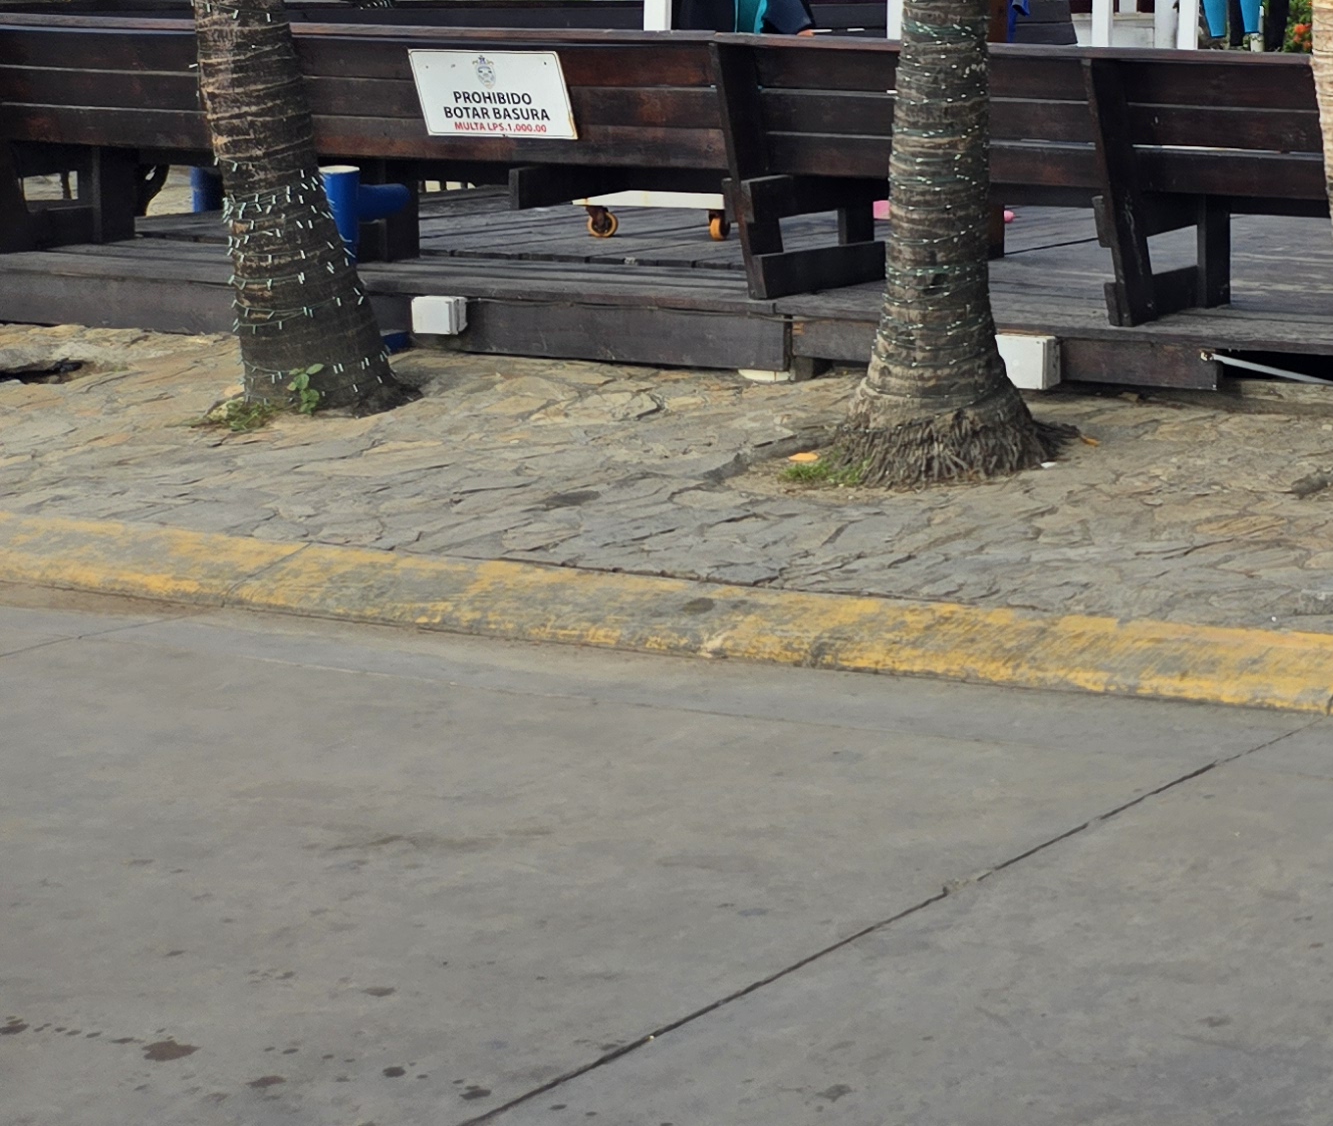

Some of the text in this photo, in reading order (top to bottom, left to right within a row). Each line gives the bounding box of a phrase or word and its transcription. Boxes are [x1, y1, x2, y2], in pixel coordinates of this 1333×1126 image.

[453, 91, 532, 105] PROHIBIDO
[444, 106, 550, 121] BOTAR BASURA
[454, 122, 486, 131] MULTA
